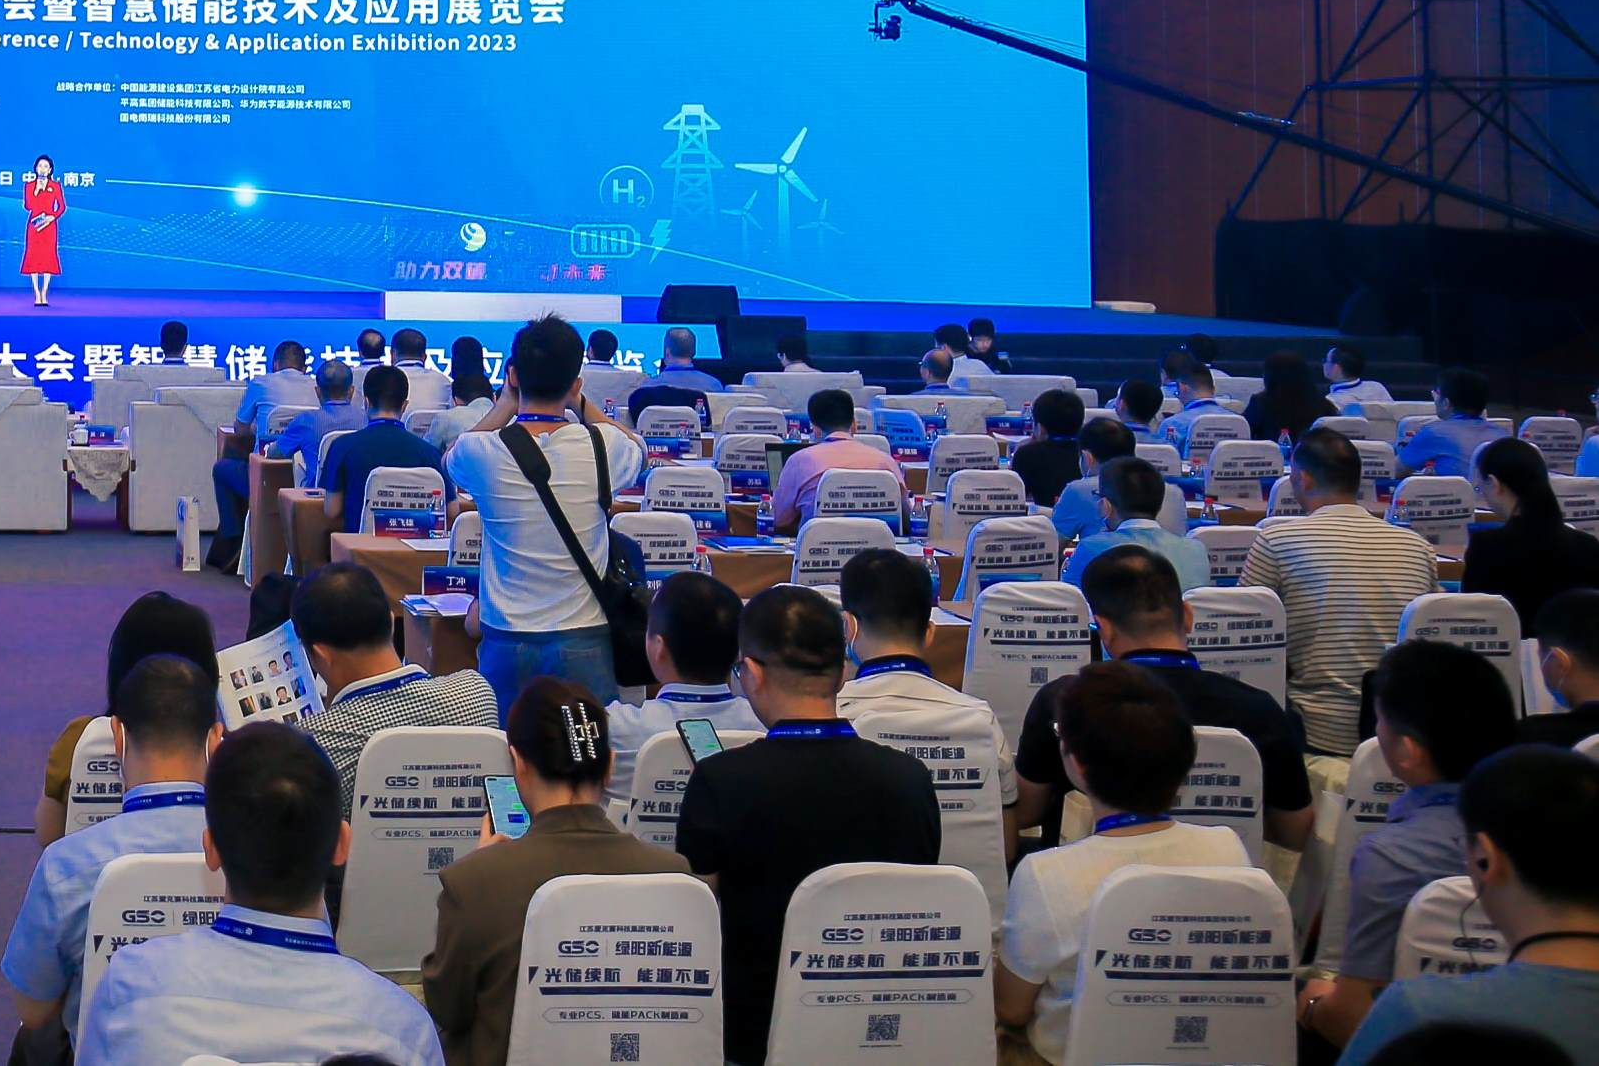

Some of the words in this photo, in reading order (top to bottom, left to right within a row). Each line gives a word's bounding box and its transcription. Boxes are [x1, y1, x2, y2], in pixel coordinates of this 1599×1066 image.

[79, 30, 200, 55] Technology
[205, 32, 219, 51] &
[225, 31, 345, 57] Application
[352, 32, 460, 53] Exhibition
[466, 33, 518, 53] 2023
[905, 746, 965, 759] 绿阳新能源
[76, 782, 122, 794] 光储续
[433, 774, 484, 787] 绿阳新能
[452, 796, 487, 808] 能源
[643, 800, 682, 813] 光储
[881, 926, 961, 942] 绿阳新能源
[1188, 929, 1272, 944] 绿阳新能源
[615, 940, 693, 957] 绿阳新能源
[903, 951, 980, 967] 能源不断
[1210, 954, 1290, 969] 能源不断
[637, 968, 710, 984] 能源不断
